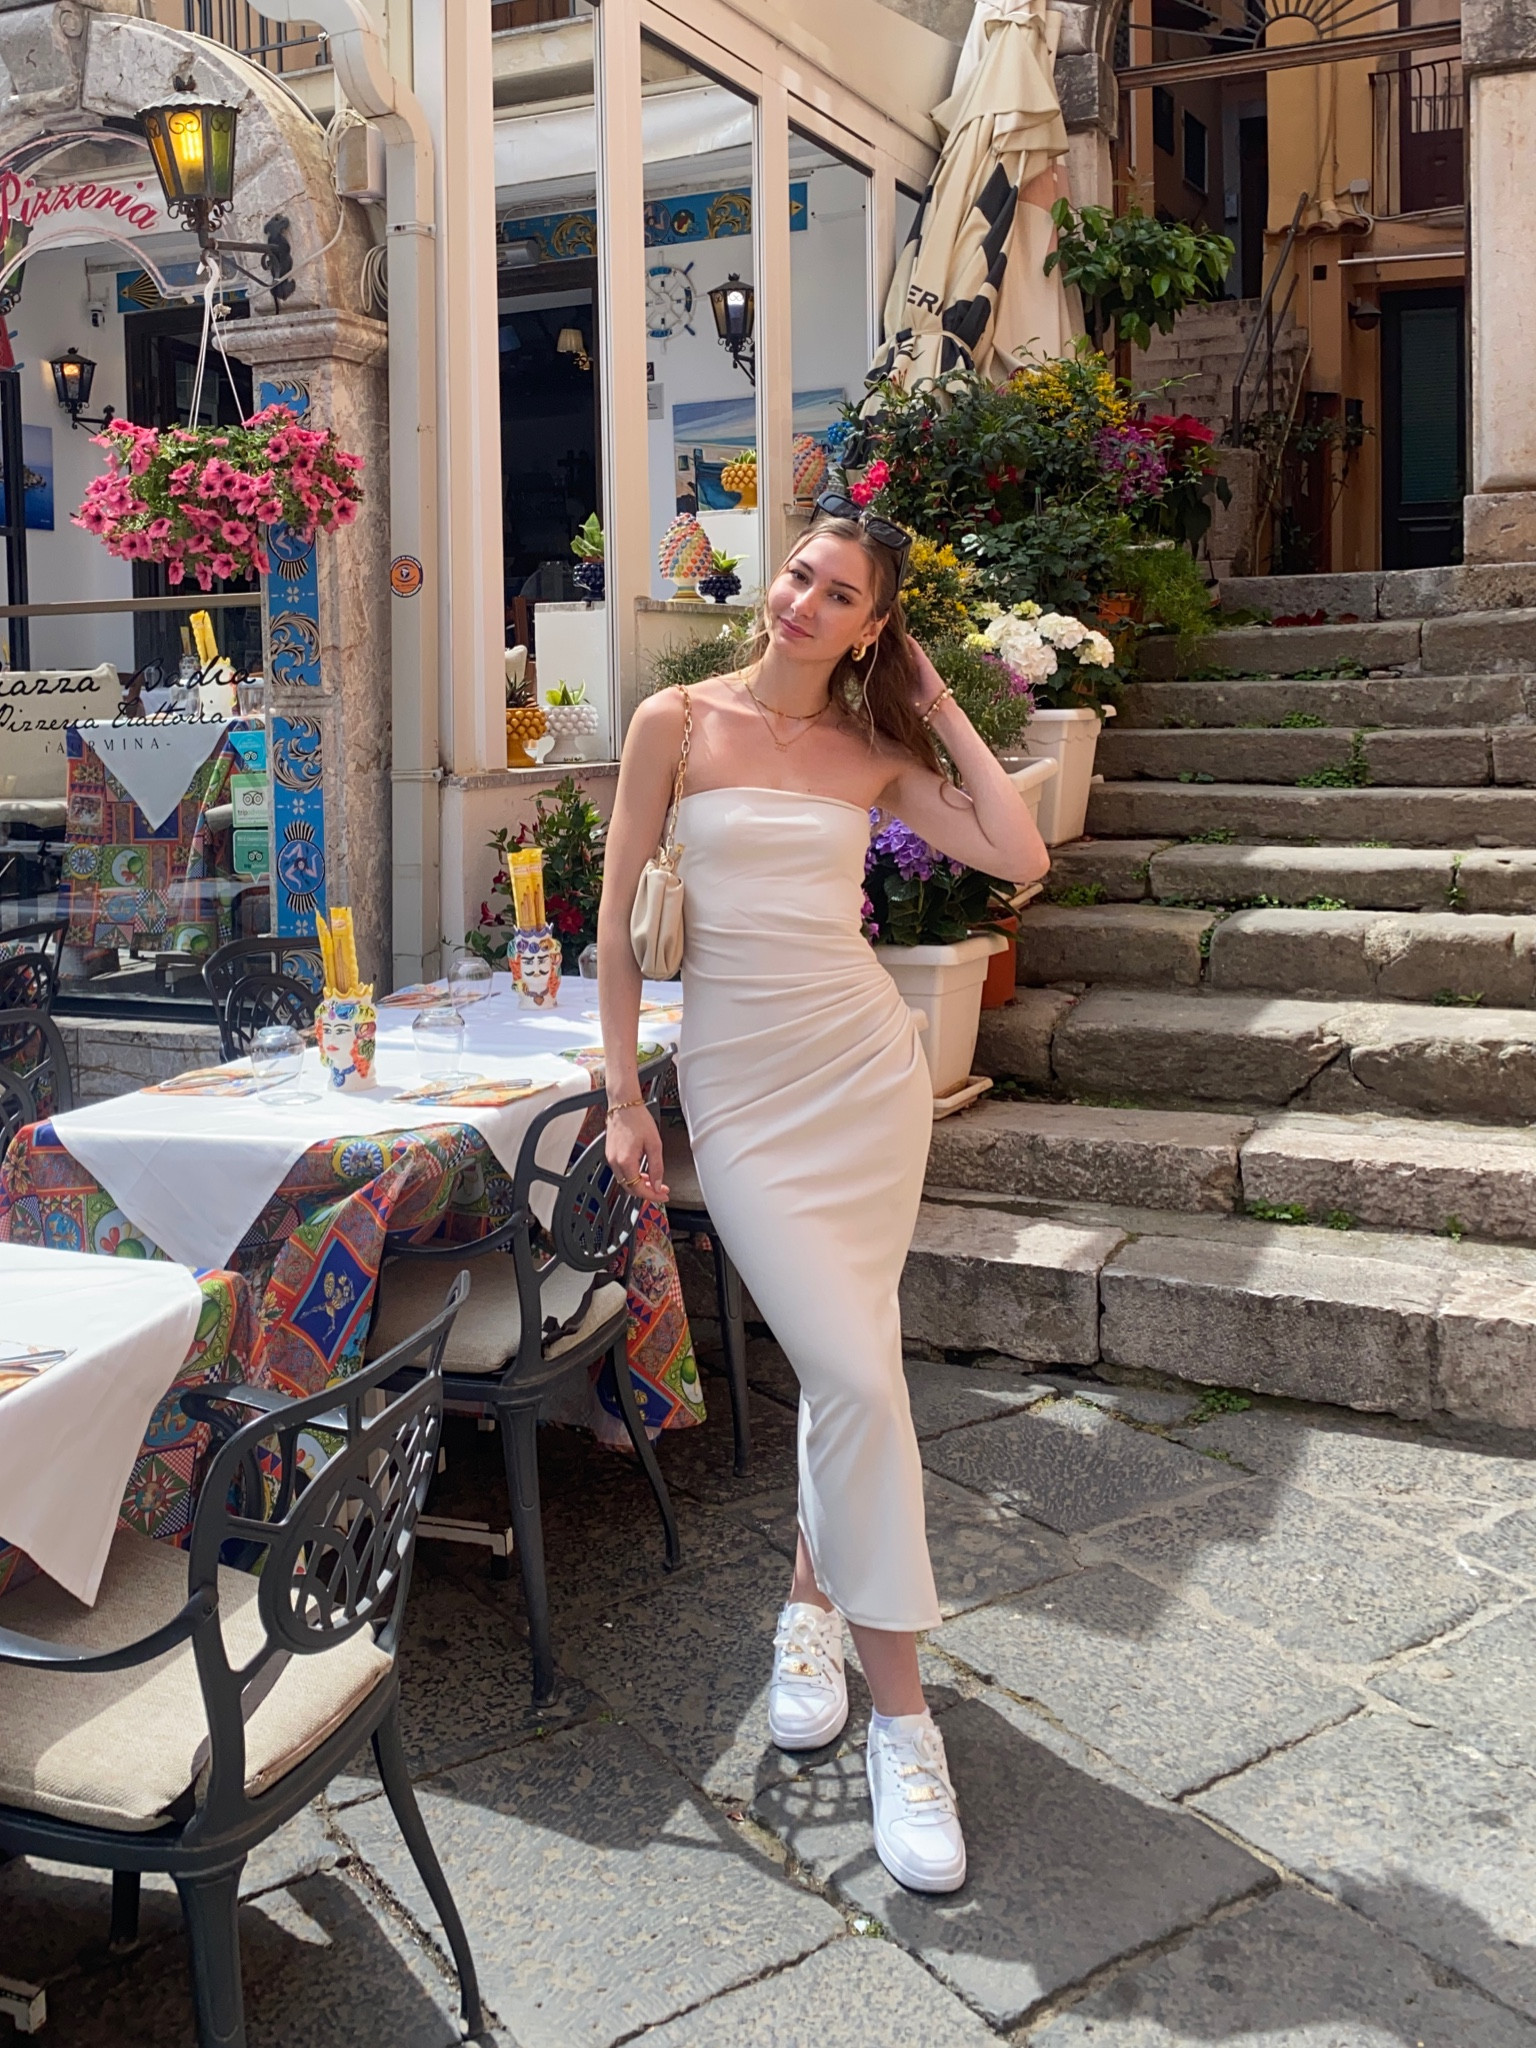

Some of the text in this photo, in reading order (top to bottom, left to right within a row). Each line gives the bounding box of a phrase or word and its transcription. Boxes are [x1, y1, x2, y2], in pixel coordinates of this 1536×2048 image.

[0, 170, 157, 248] Pizzeria
[125, 655, 256, 692] Badia
[0, 697, 227, 732] Pizzeria Trattoria
